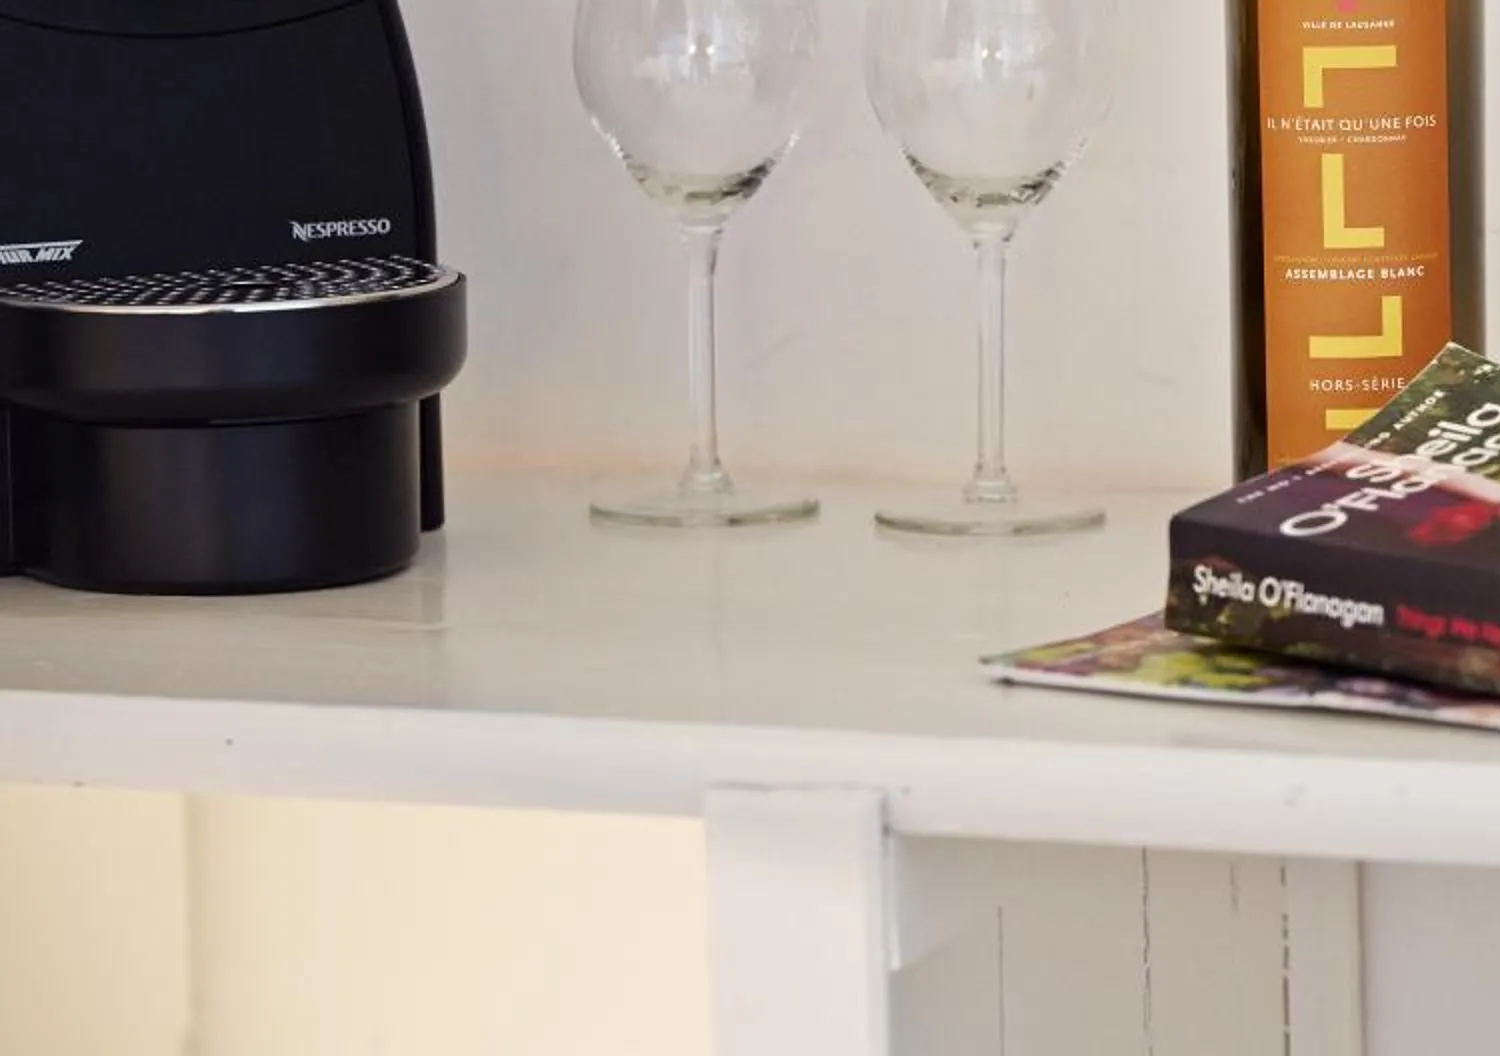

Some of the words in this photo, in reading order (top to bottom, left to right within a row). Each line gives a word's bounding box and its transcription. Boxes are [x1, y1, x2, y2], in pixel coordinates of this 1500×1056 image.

[1302, 20, 1326, 30] VILLE
[1330, 20, 1342, 30] DE
[1267, 116, 1276, 129] IL
[1405, 114, 1437, 129] FOIS
[289, 217, 392, 242] NESPRESSO
[1286, 267, 1374, 280] ASSEMBLAGE
[1380, 265, 1425, 279] BLANC
[1192, 563, 1256, 603] Sheila
[1258, 575, 1386, 629] O'Flanagan
